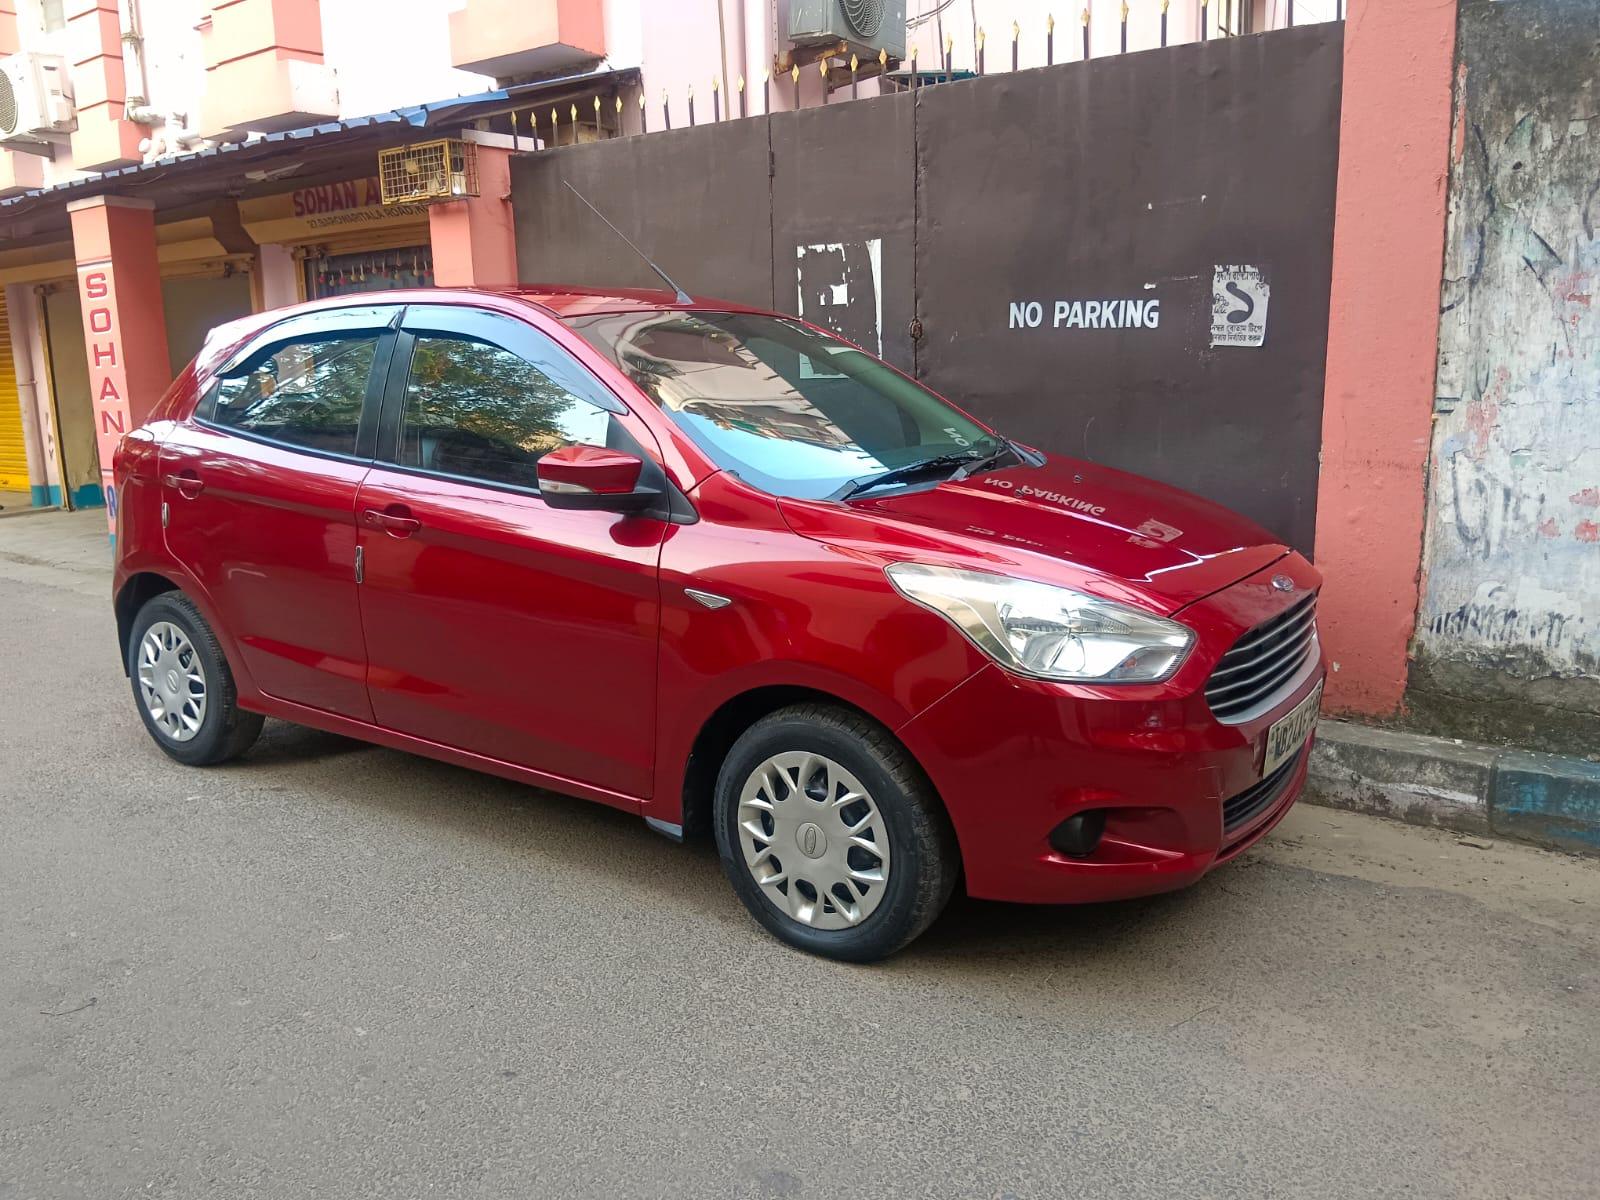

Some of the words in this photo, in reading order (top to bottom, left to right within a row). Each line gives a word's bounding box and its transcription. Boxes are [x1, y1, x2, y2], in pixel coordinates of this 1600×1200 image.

[292, 181, 358, 217] SOHAN
[1009, 302, 1042, 329] NO
[1054, 299, 1160, 329] PARKING
[86, 272, 125, 435] SOHAN
